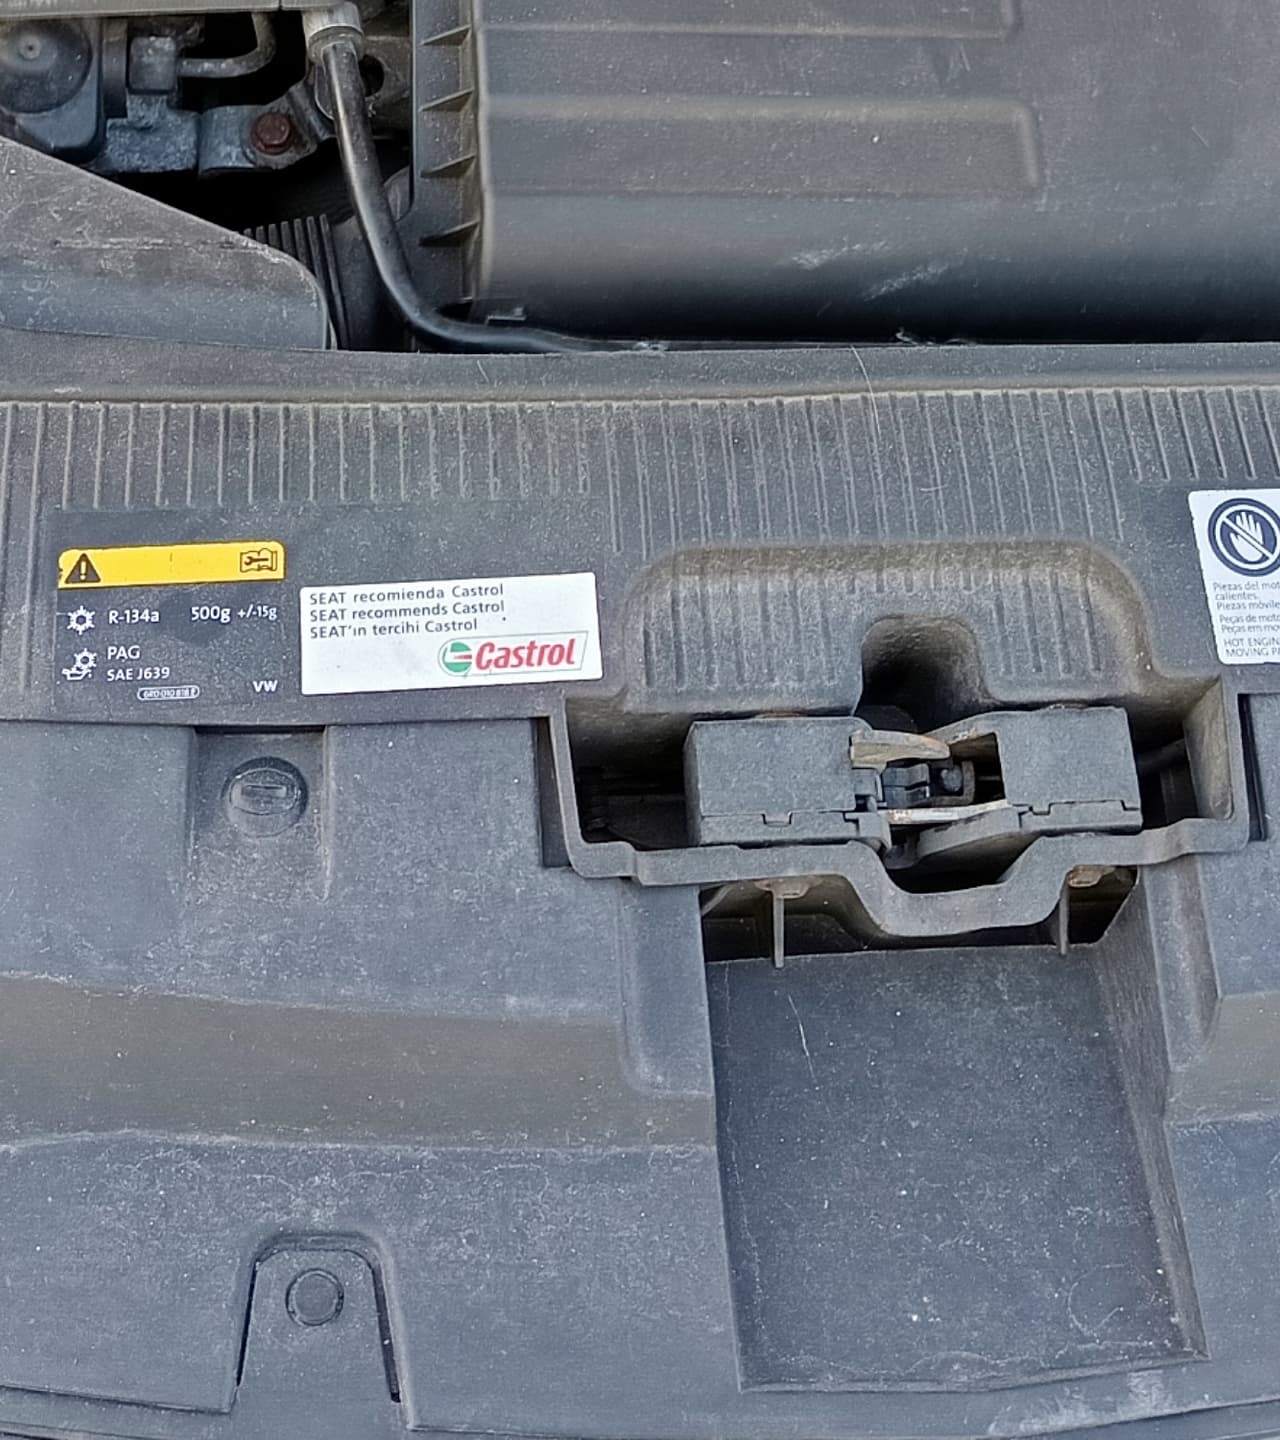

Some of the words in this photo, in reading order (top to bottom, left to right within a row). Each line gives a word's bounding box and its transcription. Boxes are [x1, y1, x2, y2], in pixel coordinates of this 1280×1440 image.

[310, 592, 347, 605] SEAT
[353, 587, 445, 603] recomienda
[451, 583, 504, 598] Castrol
[108, 609, 160, 624] R-134a
[191, 605, 231, 623] 500g
[310, 608, 347, 622] SEAT
[352, 603, 448, 620] recommends
[452, 600, 505, 615] Castrol
[372, 621, 420, 637] tercihi
[425, 618, 478, 633] Castrol
[107, 645, 141, 660] PAG
[475, 638, 576, 671] Castrol
[107, 668, 133, 681] SAE
[136, 666, 170, 680] J639
[253, 680, 278, 692] VW
